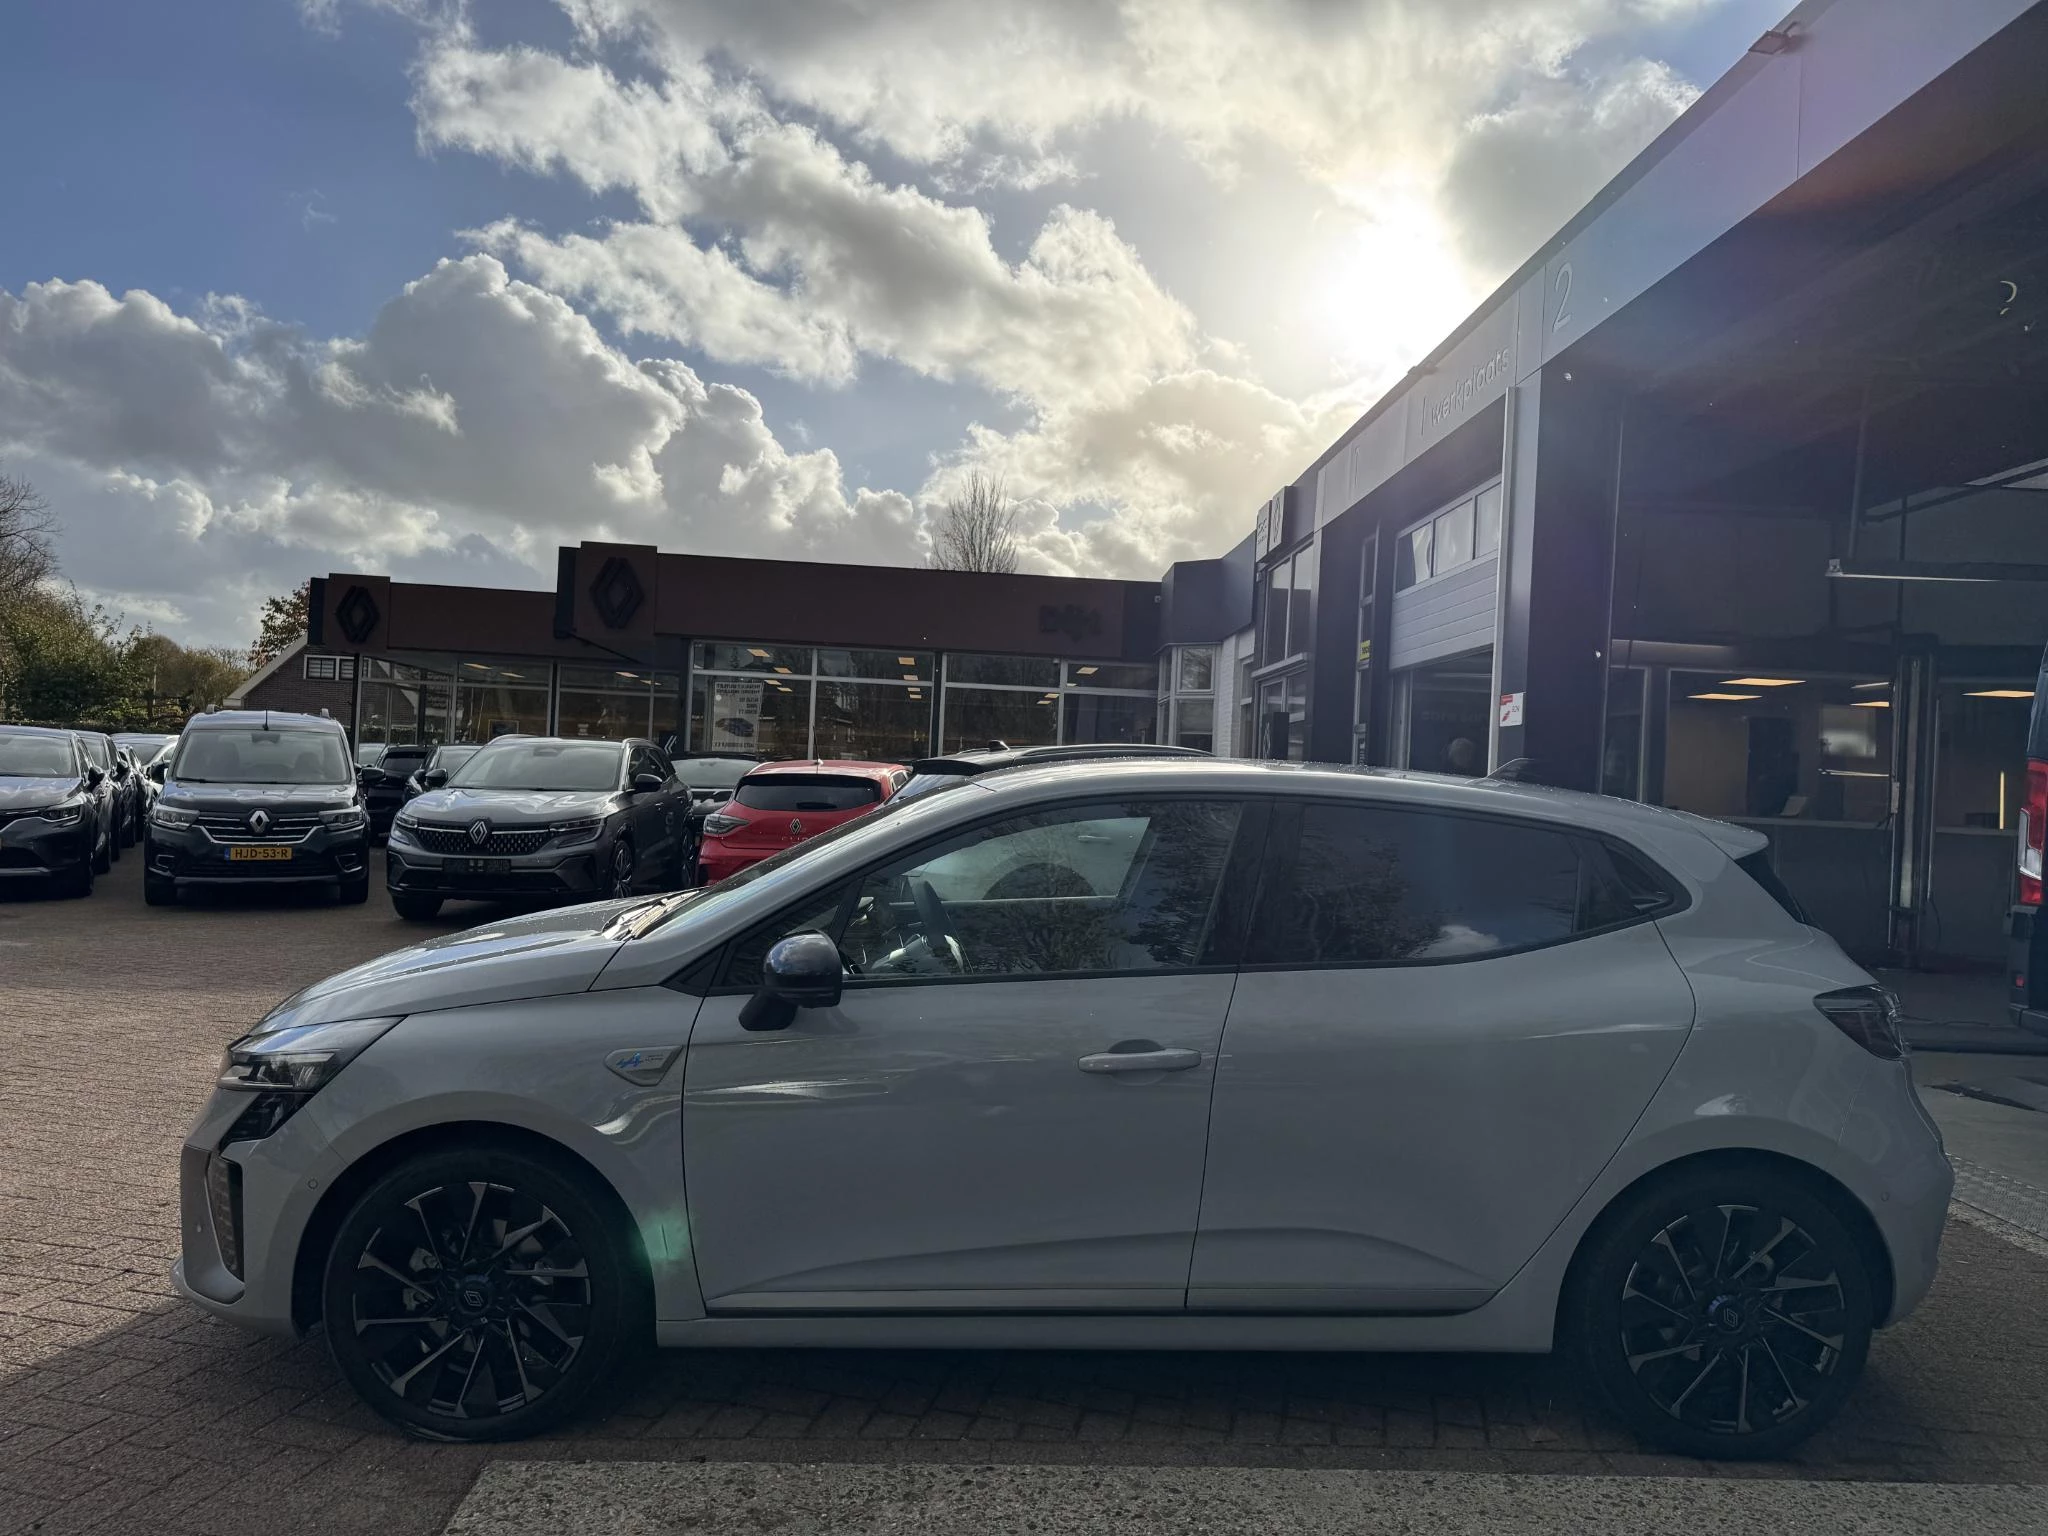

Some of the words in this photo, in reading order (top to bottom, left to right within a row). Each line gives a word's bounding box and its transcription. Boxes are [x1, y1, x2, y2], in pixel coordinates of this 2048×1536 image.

[1552, 261, 1573, 334] 2
[1431, 347, 1510, 427] werkplaats
[235, 848, 288, 859] HJD-53-R
